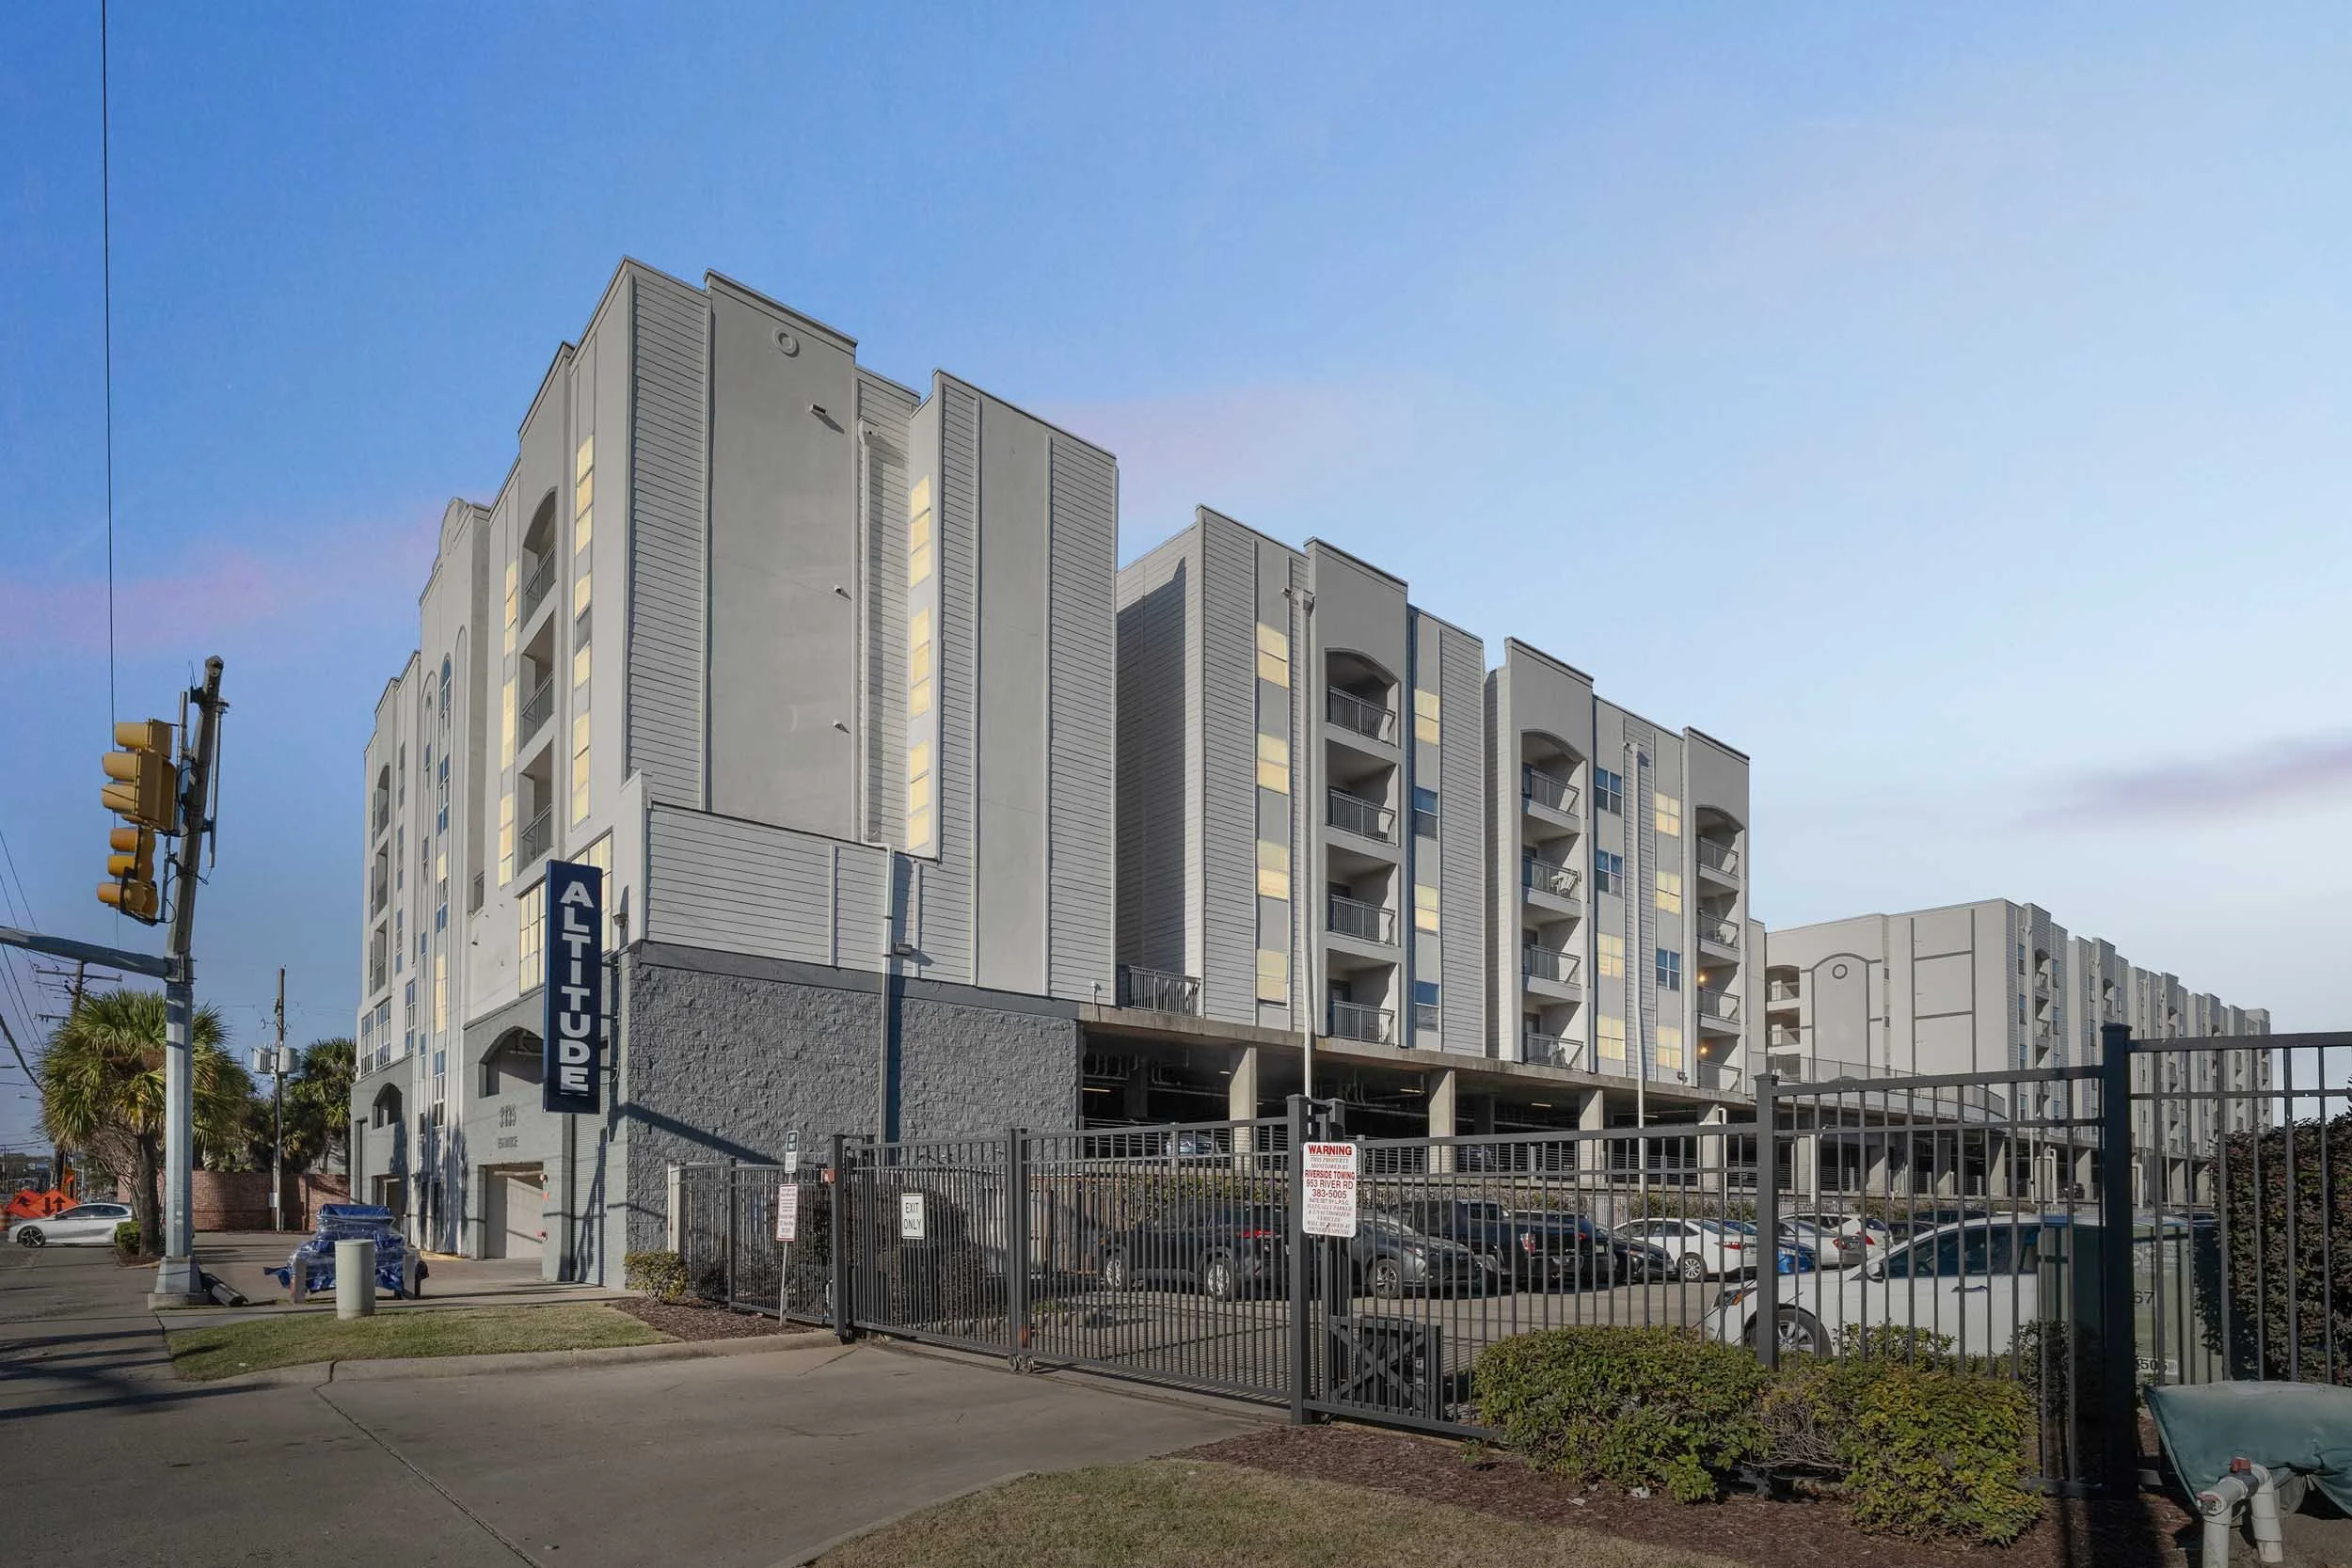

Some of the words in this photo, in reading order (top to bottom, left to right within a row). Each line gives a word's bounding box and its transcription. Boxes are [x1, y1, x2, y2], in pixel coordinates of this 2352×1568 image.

[559, 880, 595, 1092] ALTITUDE
[1309, 1145, 1352, 1155] WARNING
[1305, 1169, 1332, 1179] RIVERSIDE
[1333, 1170, 1355, 1180] TOWING
[1306, 1179, 1318, 1188] 953
[1320, 1180, 1342, 1189] RIVER
[1343, 1180, 1354, 1190] RD
[1311, 1188, 1347, 1199] 383-5005
[905, 1202, 919, 1213] EXIT
[904, 1218, 921, 1230] ONLY
